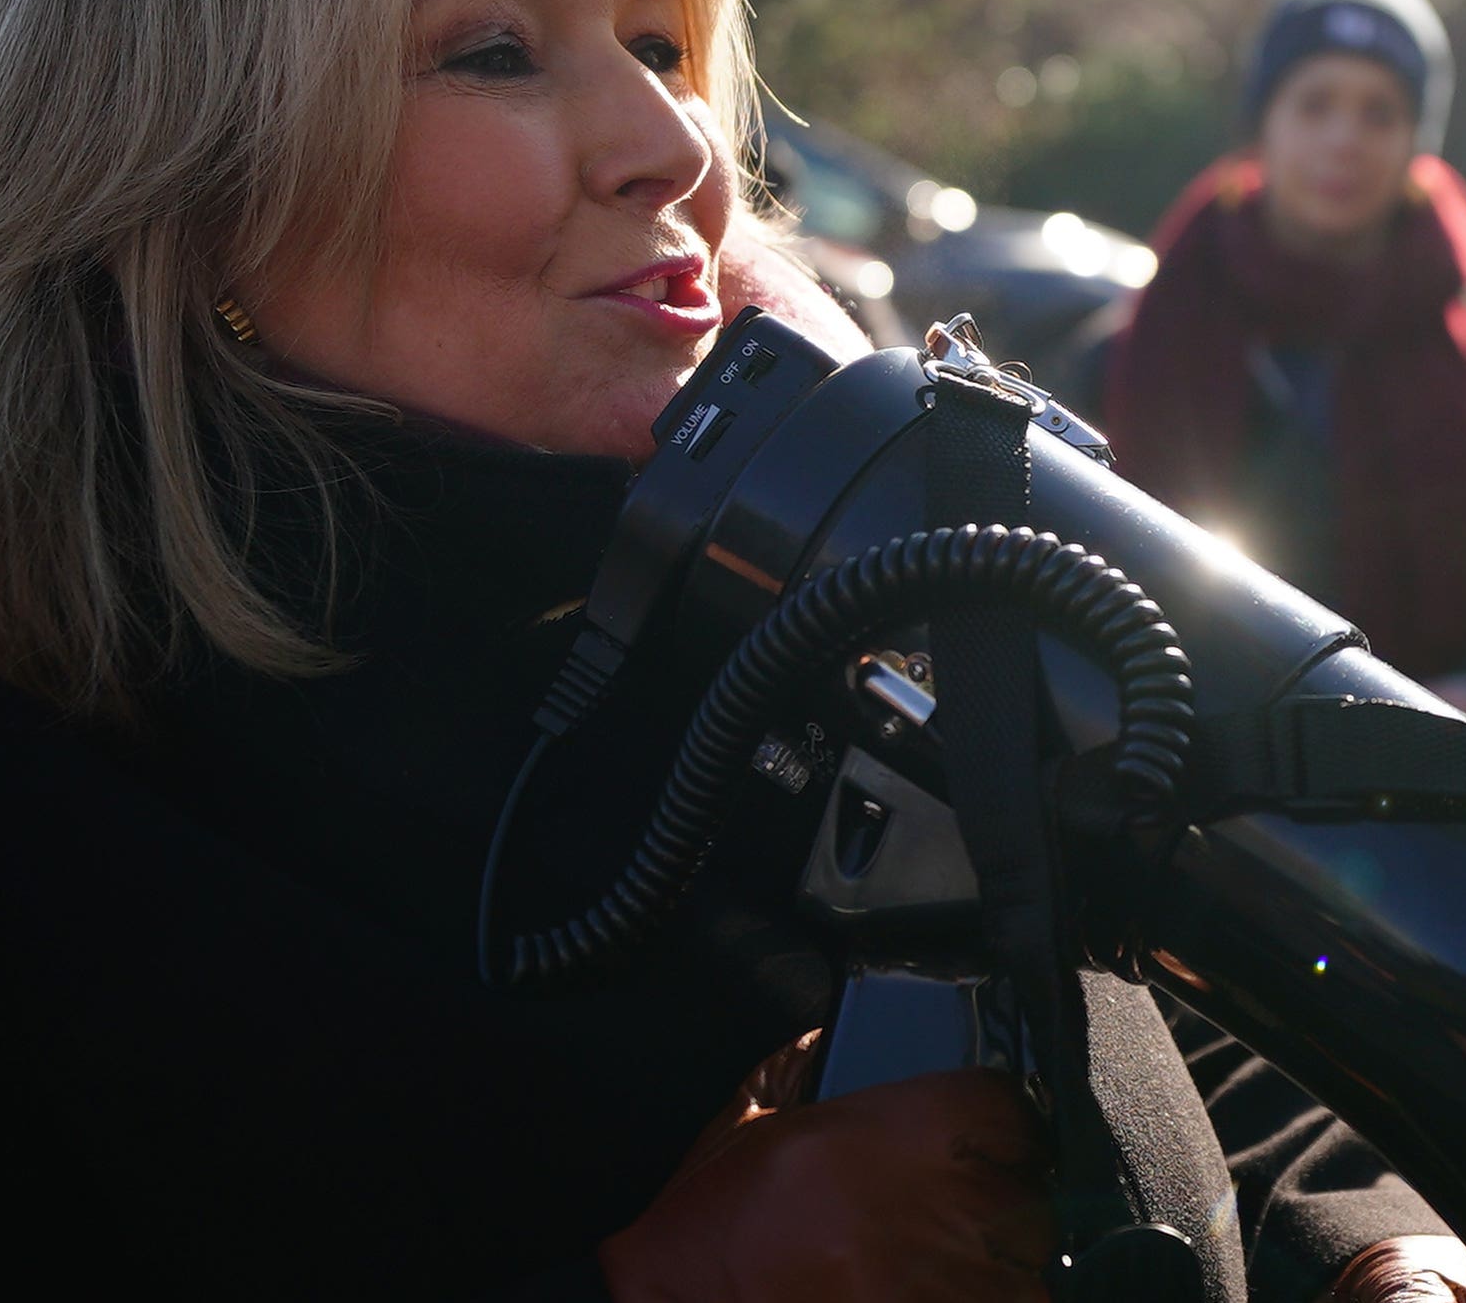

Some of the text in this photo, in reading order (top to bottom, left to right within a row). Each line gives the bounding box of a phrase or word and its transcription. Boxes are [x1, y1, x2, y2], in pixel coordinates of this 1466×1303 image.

[720, 338, 759, 384] OFF ON
[671, 403, 708, 445] VOLUME
